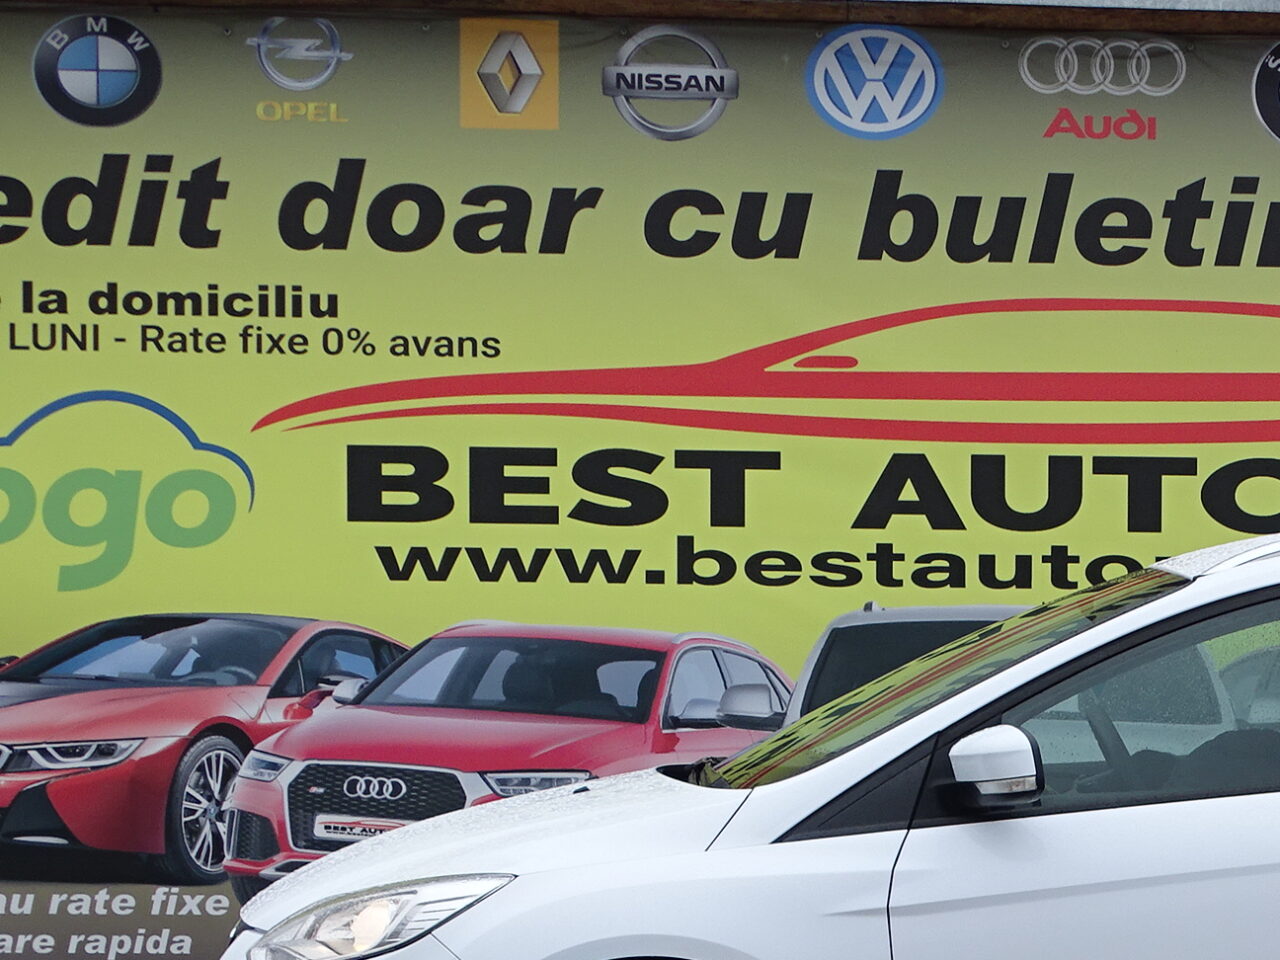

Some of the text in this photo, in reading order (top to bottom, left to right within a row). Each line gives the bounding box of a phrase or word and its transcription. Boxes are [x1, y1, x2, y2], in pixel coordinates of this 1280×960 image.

[46, 16, 151, 53] BMW
[615, 72, 726, 95] NISSAN
[255, 101, 349, 123] OPEL
[0, 153, 230, 249] edit
[277, 157, 605, 255] doar
[643, 188, 813, 260] cu
[22, 280, 340, 319] la domiciliu
[9, 322, 100, 352] LUNI
[140, 324, 227, 354] Rate
[239, 325, 309, 356] fixe
[322, 327, 376, 357] 0%
[389, 335, 501, 359] avans
[346, 444, 782, 528] BEST
[375, 535, 1172, 592] www.bestauto
[48, 887, 136, 916] rate
[150, 887, 230, 916] fixe
[67, 928, 193, 960] rapida
